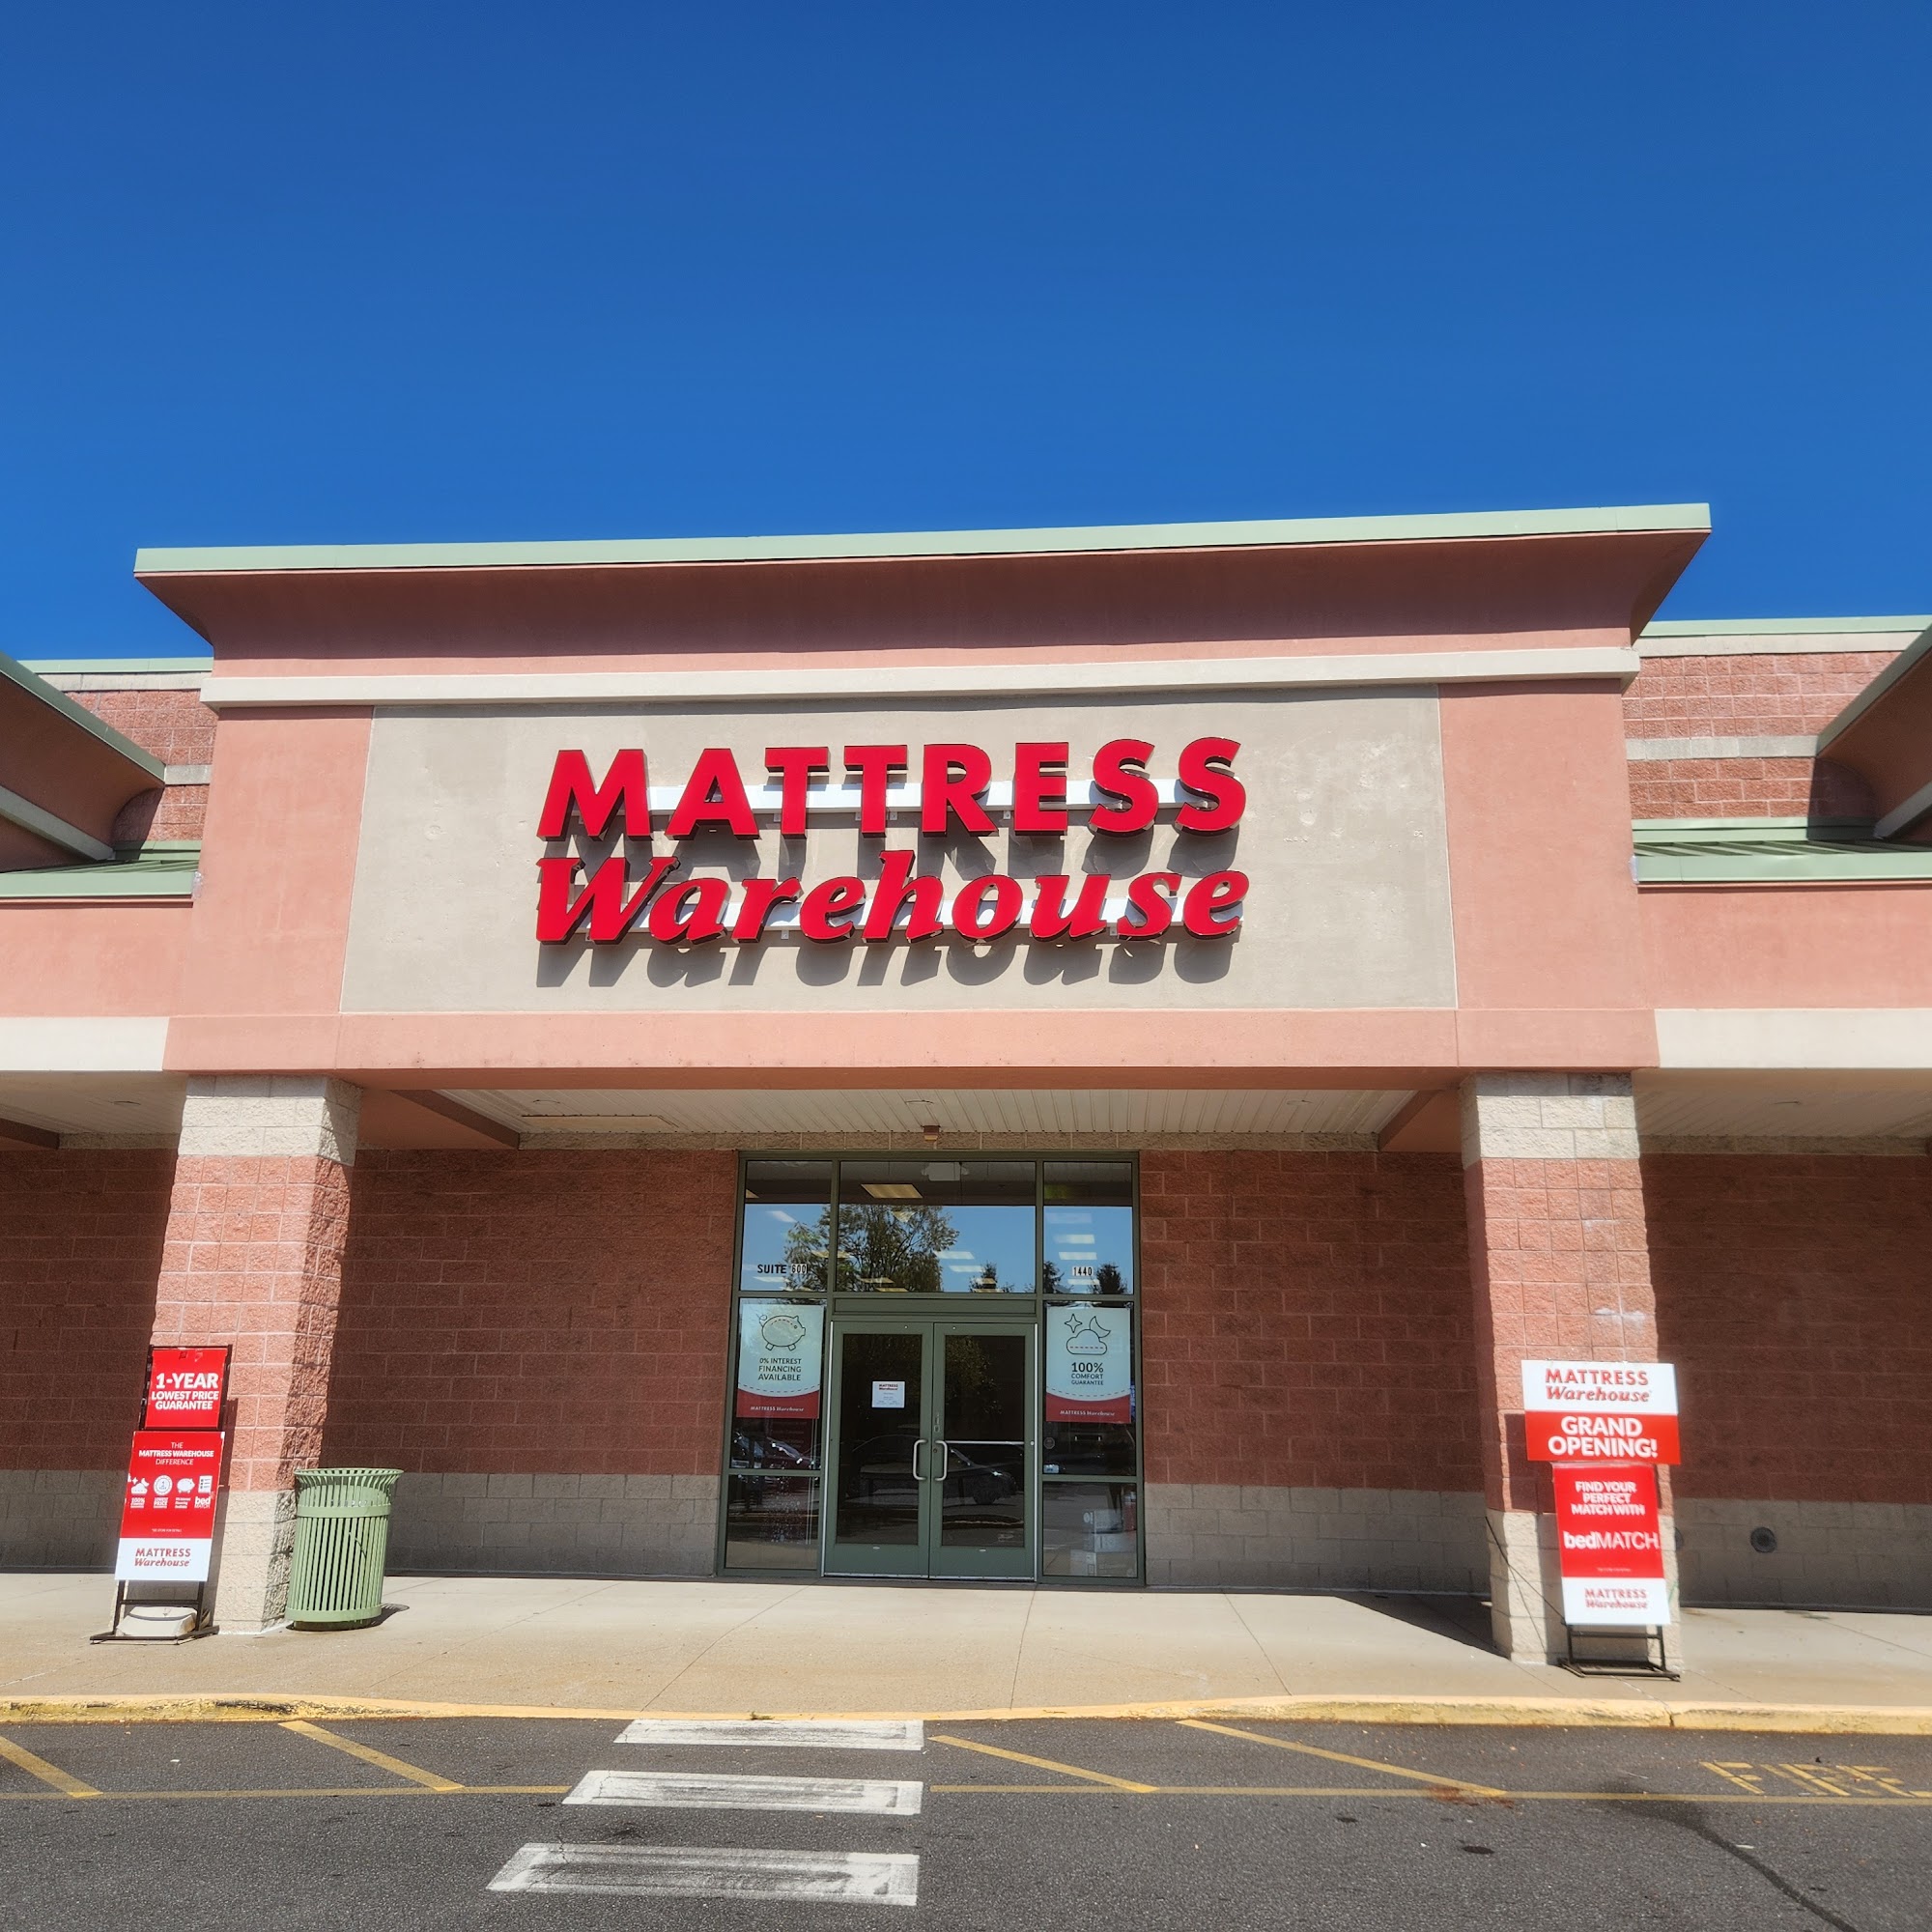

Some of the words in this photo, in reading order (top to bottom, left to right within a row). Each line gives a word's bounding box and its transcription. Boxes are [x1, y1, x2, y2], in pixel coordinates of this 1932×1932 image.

[536, 737, 1247, 840] MATTRESS
[536, 849, 1250, 945] Warehouse
[757, 1264, 787, 1274] SUITE
[791, 1264, 809, 1274] 600
[1073, 1266, 1093, 1276] 1440
[1071, 1362, 1104, 1373] 100%
[156, 1373, 219, 1389] 1-YEAR
[1545, 1368, 1649, 1386] MATTRESS
[151, 1391, 190, 1401] LOWEST
[191, 1391, 219, 1401] PRICE
[1546, 1385, 1650, 1403] Warehouse
[155, 1400, 213, 1410] GUARANTEE
[1561, 1416, 1643, 1437] GRAND
[1548, 1436, 1658, 1458] OPENING!
[1575, 1481, 1604, 1492] FIND
[1604, 1481, 1637, 1492] YOUR
[1582, 1492, 1632, 1504] PERFECT
[1571, 1504, 1611, 1515] MATCH
[1612, 1504, 1645, 1515] WITH
[1563, 1531, 1659, 1550] bedMATCH
[136, 1548, 191, 1557] MATTRESS
[134, 1558, 190, 1567] Warehouse
[1584, 1589, 1647, 1598] MATTRESS
